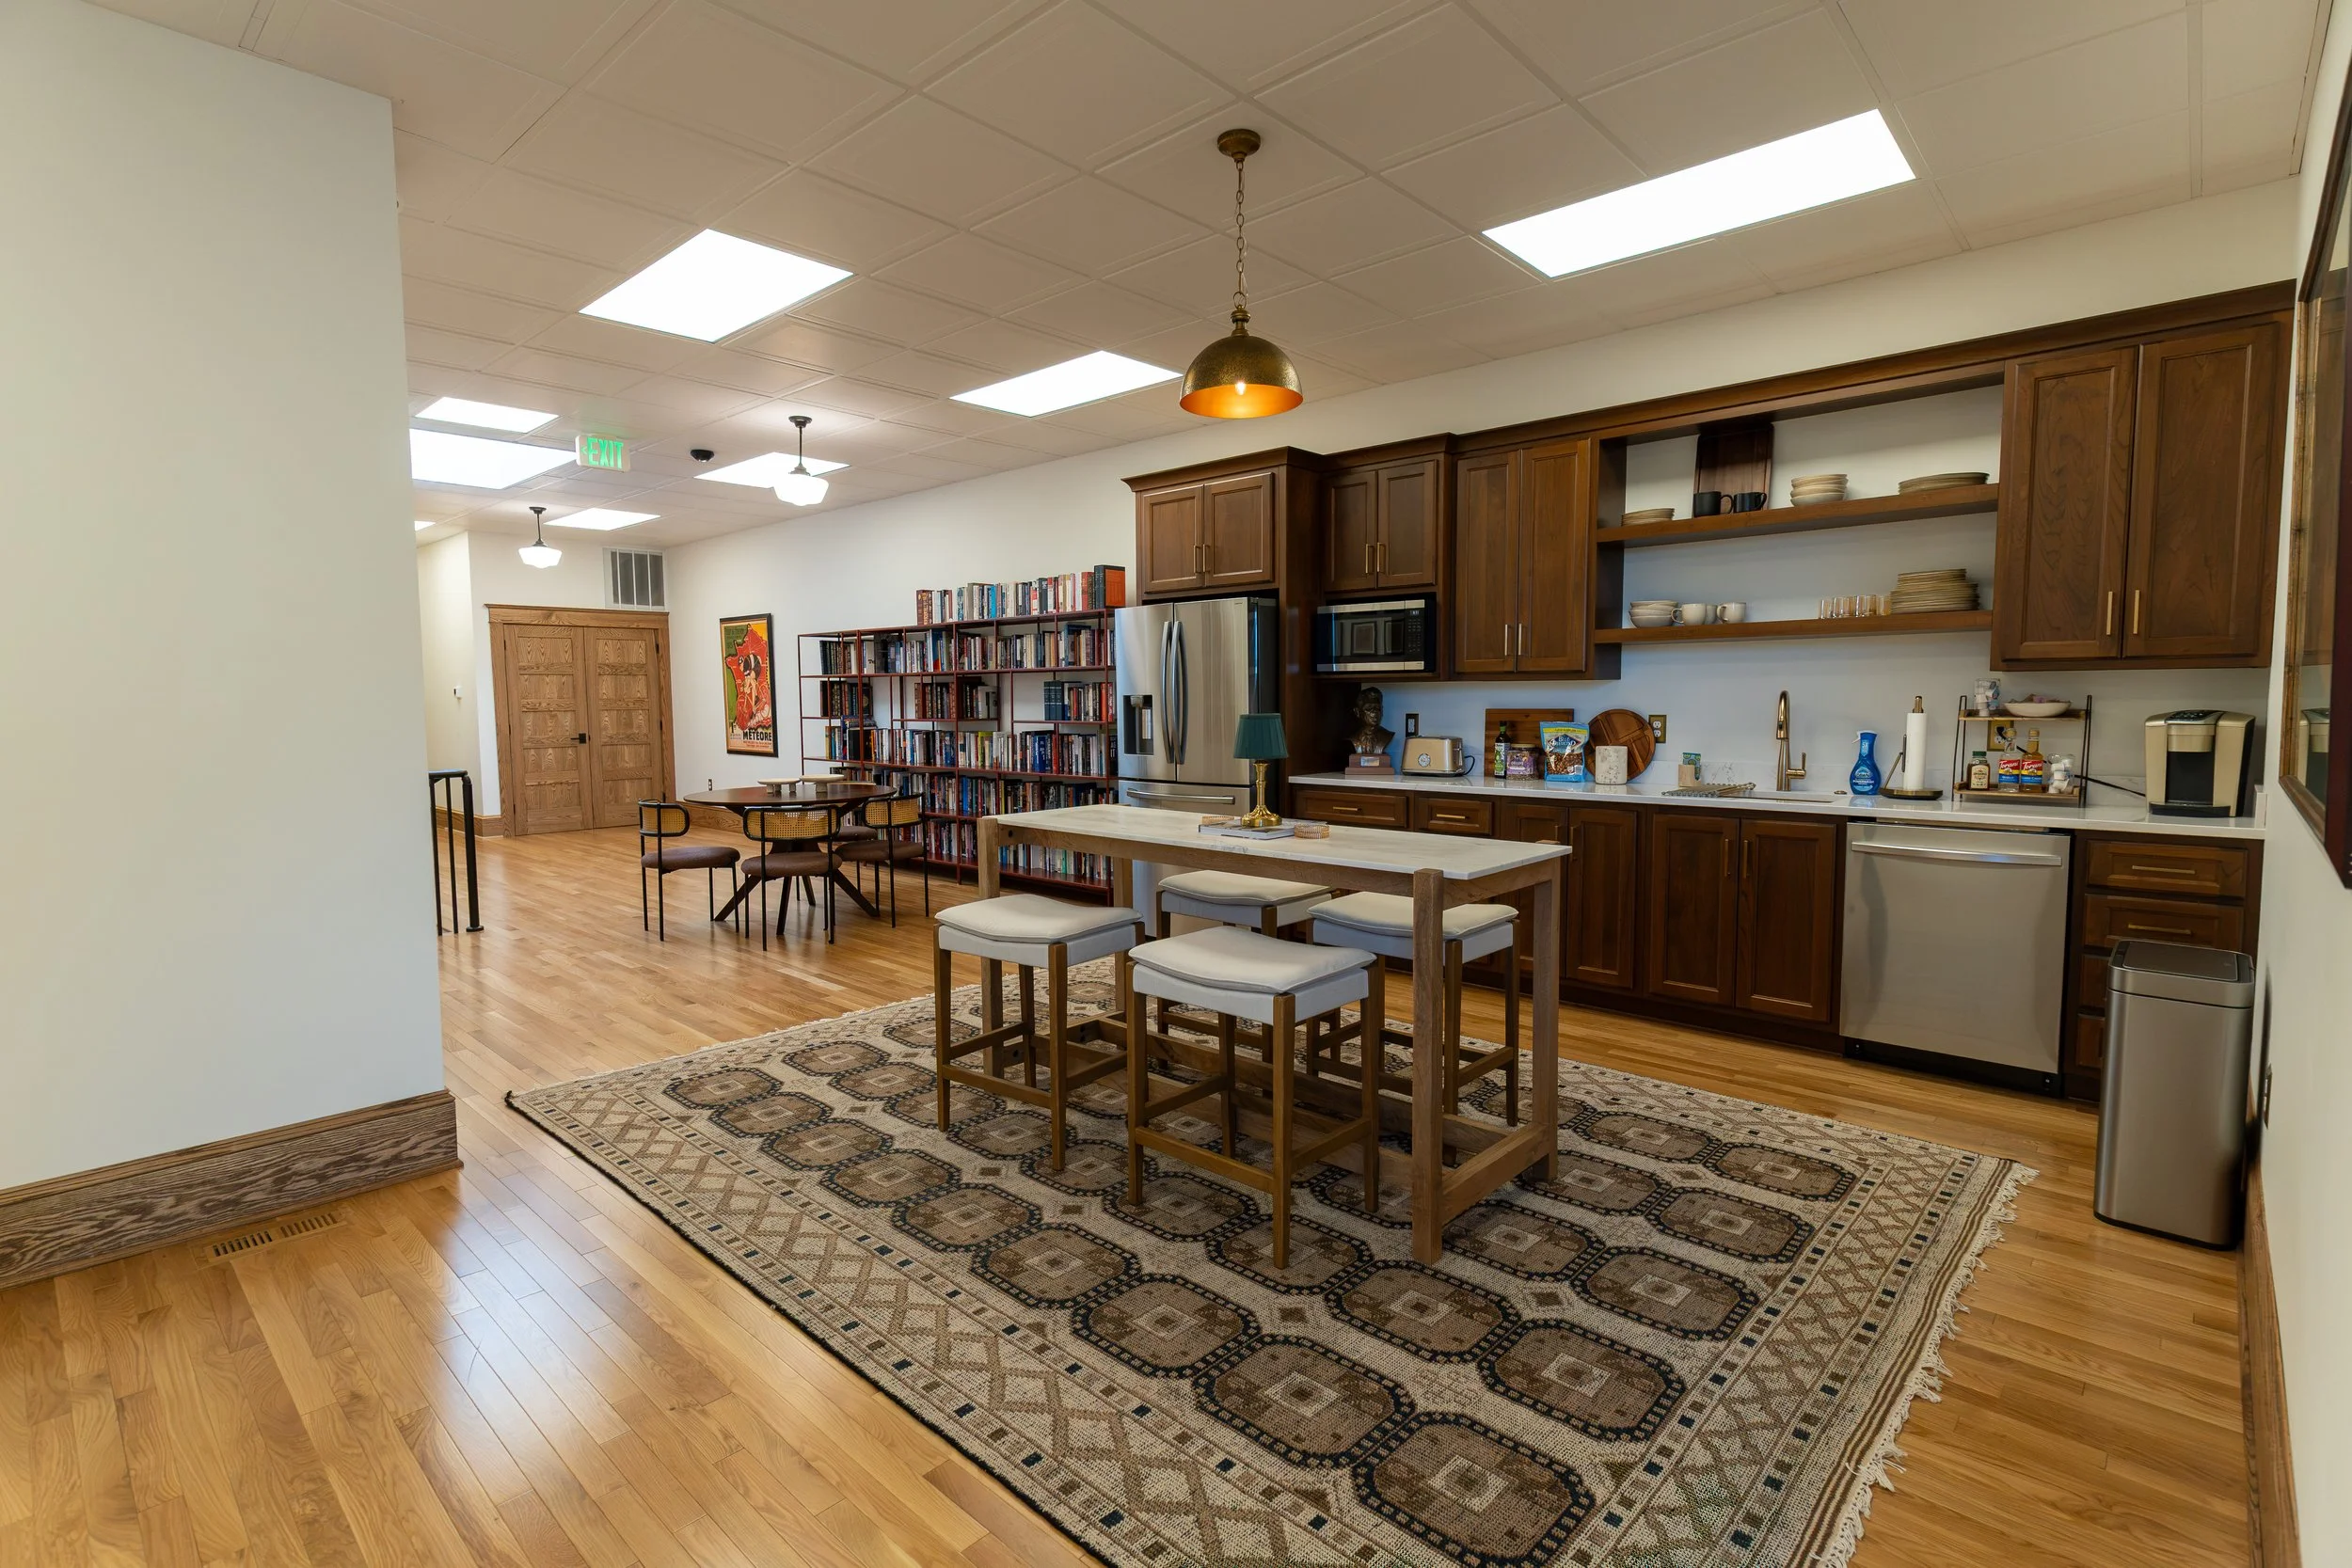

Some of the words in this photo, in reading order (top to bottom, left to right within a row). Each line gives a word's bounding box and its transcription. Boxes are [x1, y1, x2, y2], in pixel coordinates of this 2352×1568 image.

[587, 437, 624, 468] EXIT
[1999, 760, 2019, 769] Torani
[2023, 761, 2042, 770] Torani
